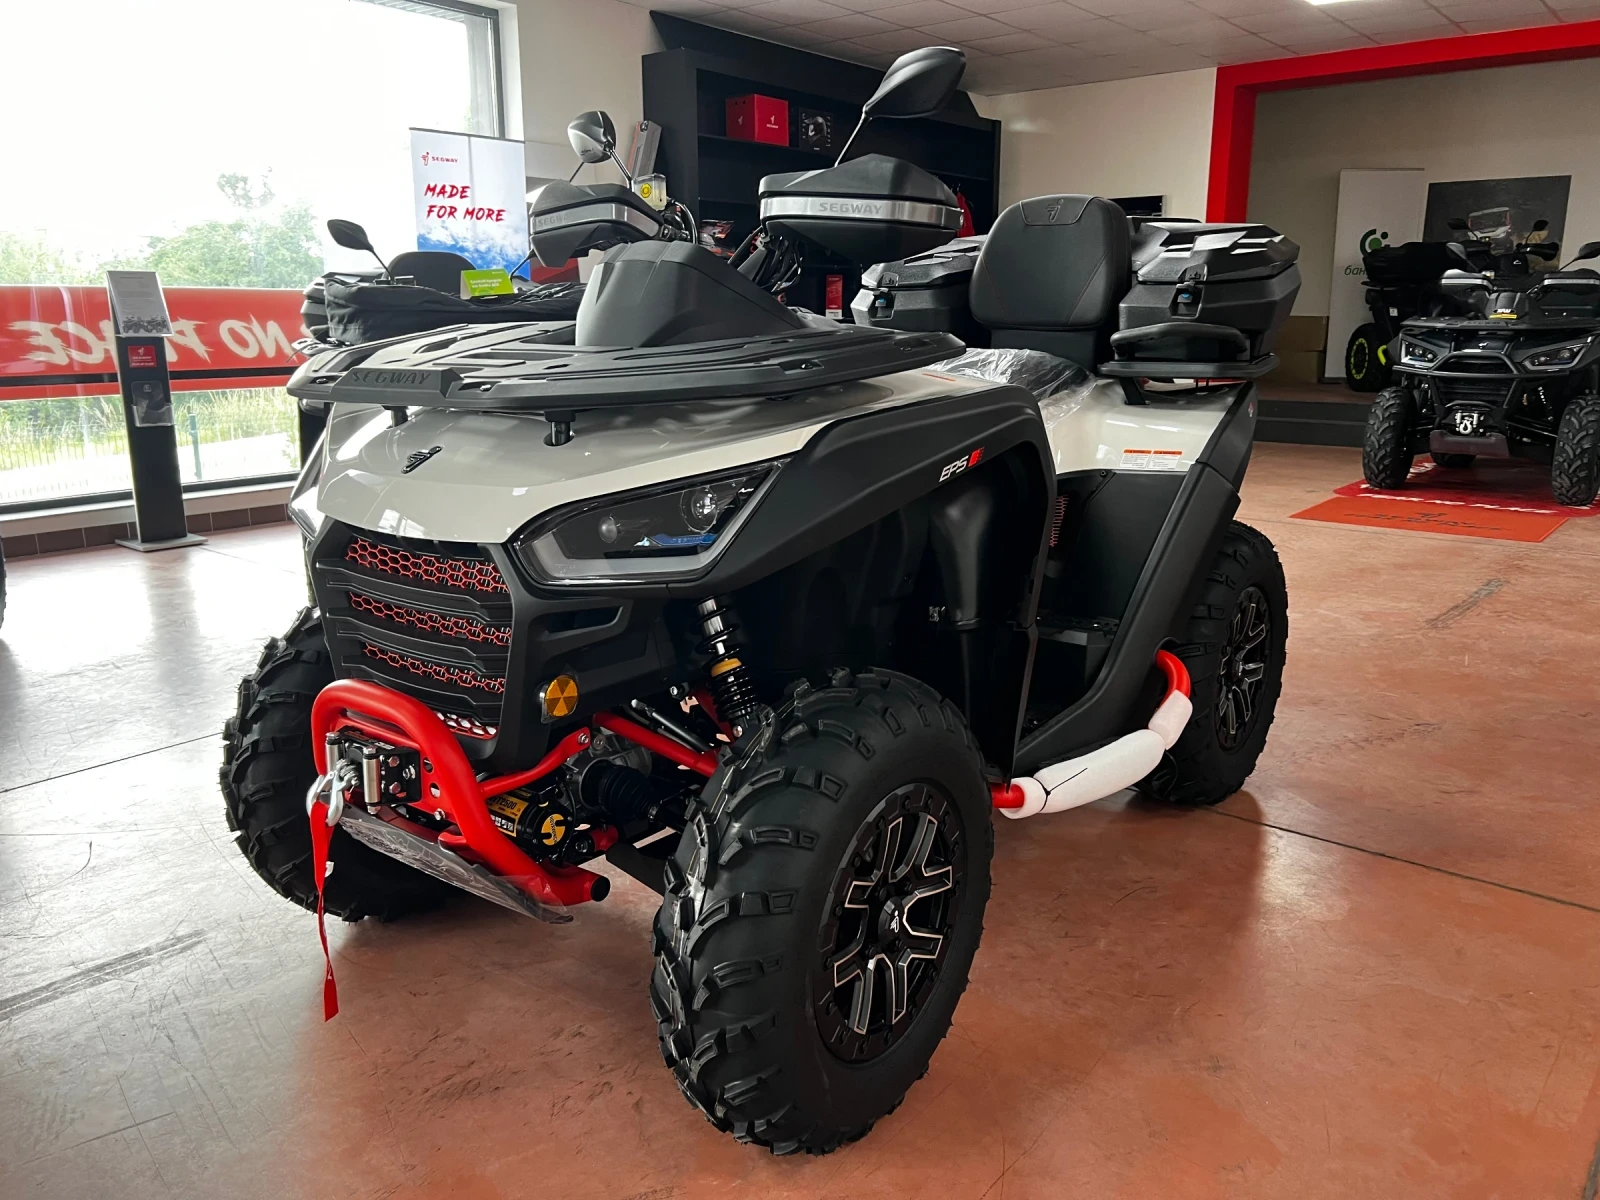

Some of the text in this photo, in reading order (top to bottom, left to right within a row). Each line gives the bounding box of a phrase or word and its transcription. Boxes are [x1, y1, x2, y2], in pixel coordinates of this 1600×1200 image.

[424, 183, 471, 199] MADE
[426, 204, 507, 223] FOR MORE
[819, 202, 883, 215] SEGWAY
[538, 211, 572, 227] SEGWA
[1344, 264, 1367, 276] бан
[352, 370, 431, 385] SEGWAY
[939, 455, 969, 482] EPS
